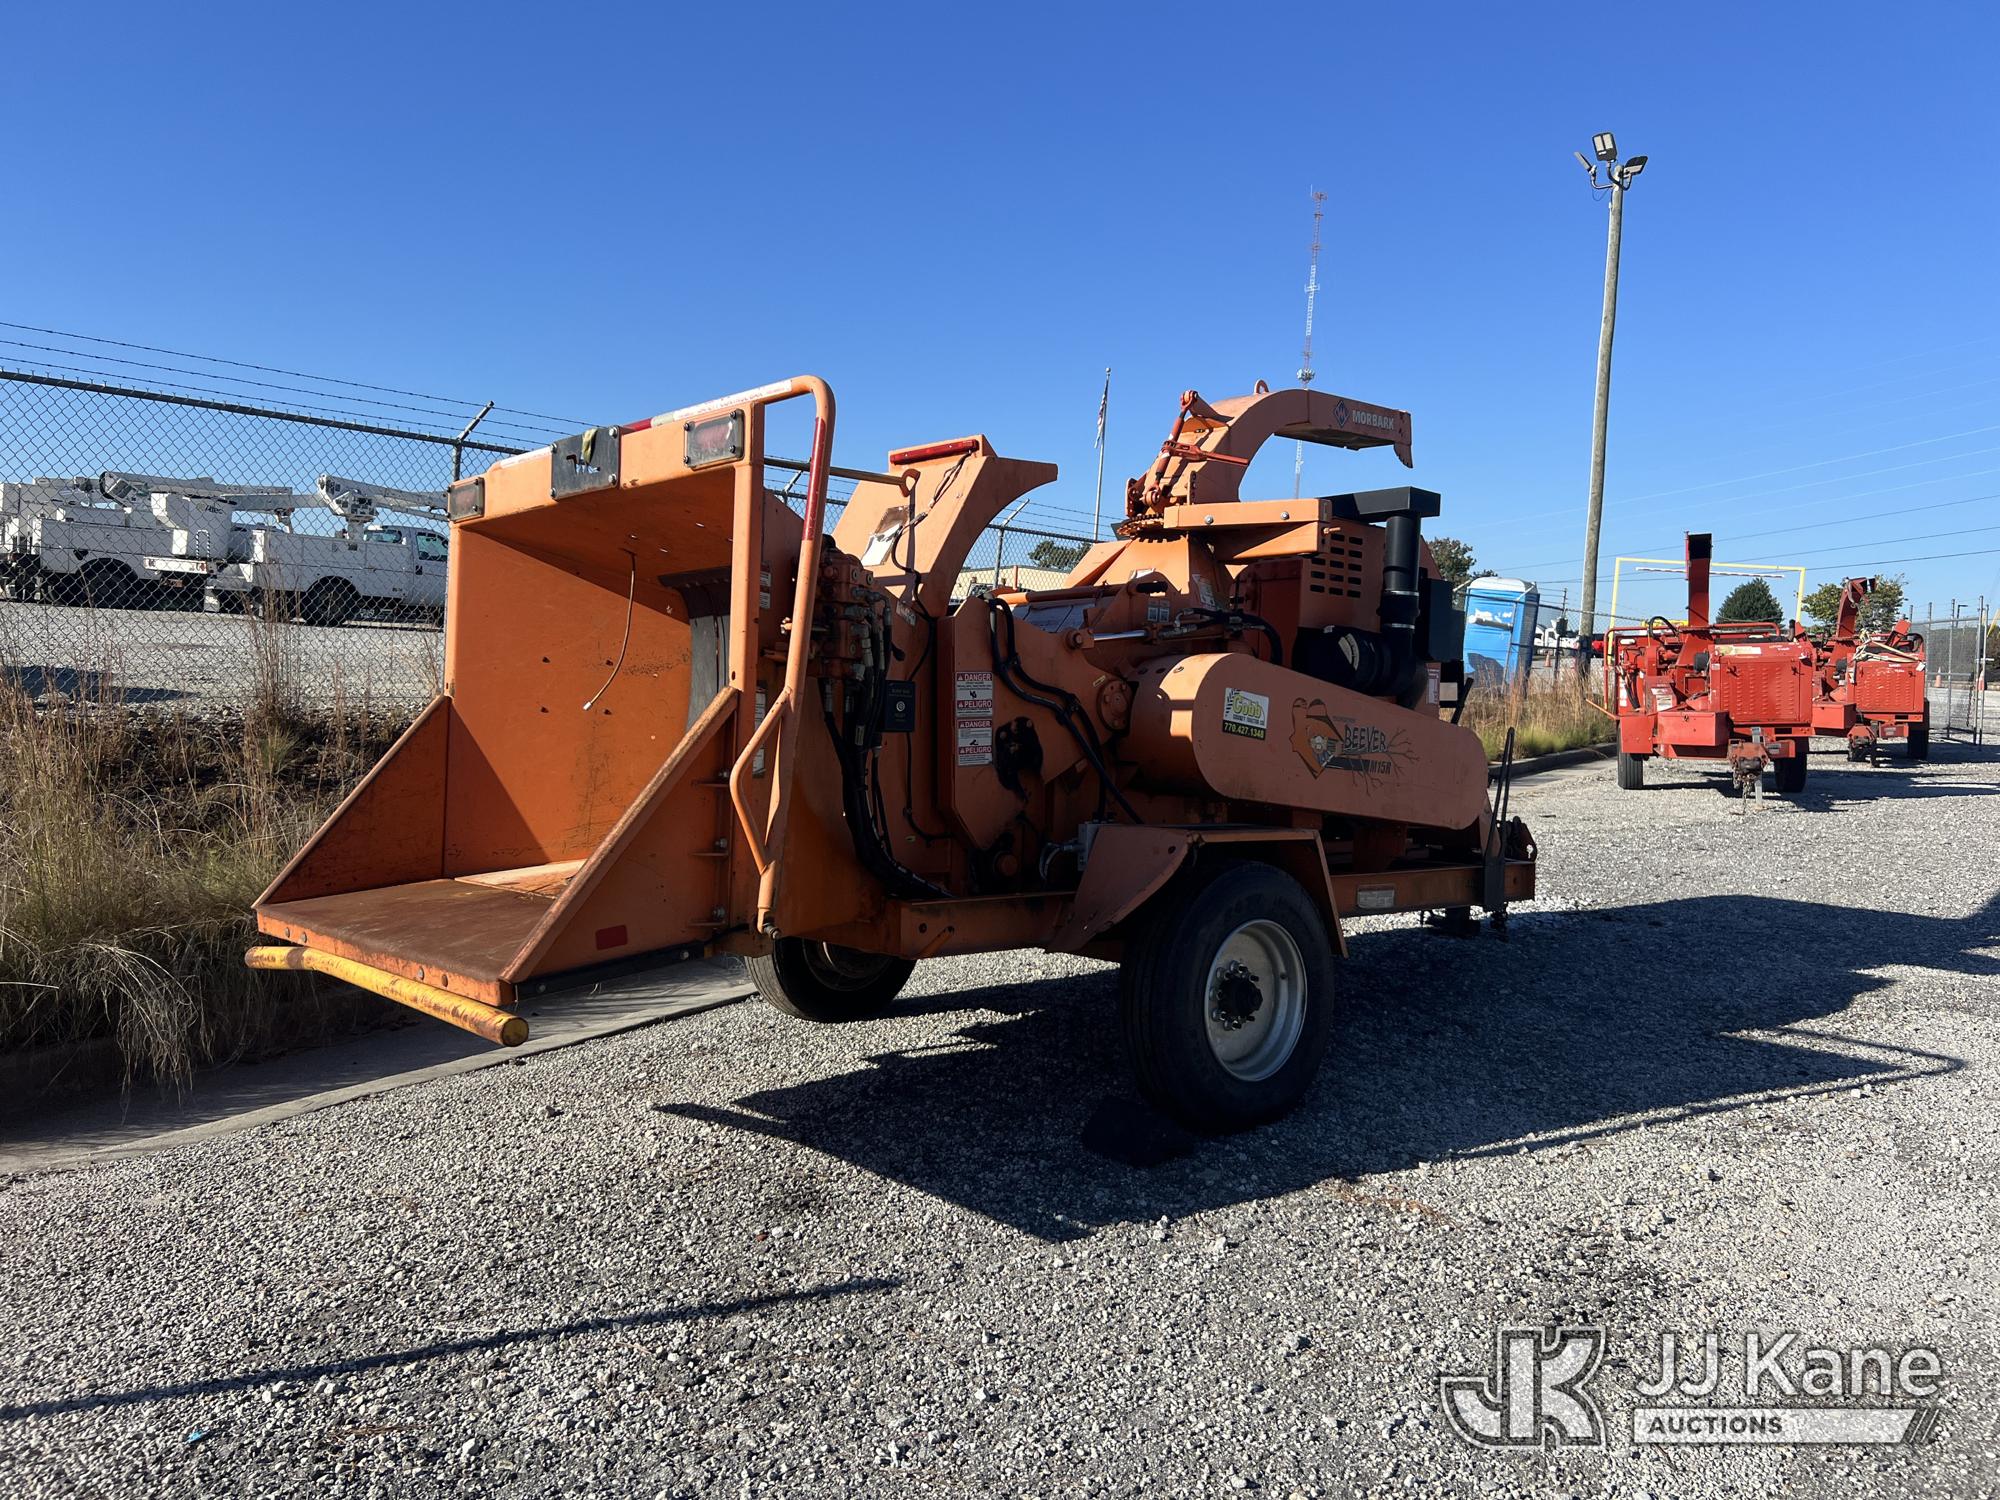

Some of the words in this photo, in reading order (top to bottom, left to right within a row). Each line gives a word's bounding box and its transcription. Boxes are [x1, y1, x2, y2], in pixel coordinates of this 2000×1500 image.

[1352, 410, 1394, 430] MORBARK
[964, 673, 991, 681] DANGER
[964, 700, 992, 708] PELIGRO
[1232, 695, 1262, 719] Cobb
[965, 720, 991, 728] DANGER
[1344, 726, 1386, 752] BEEVER
[965, 746, 992, 754] PELIGRO
